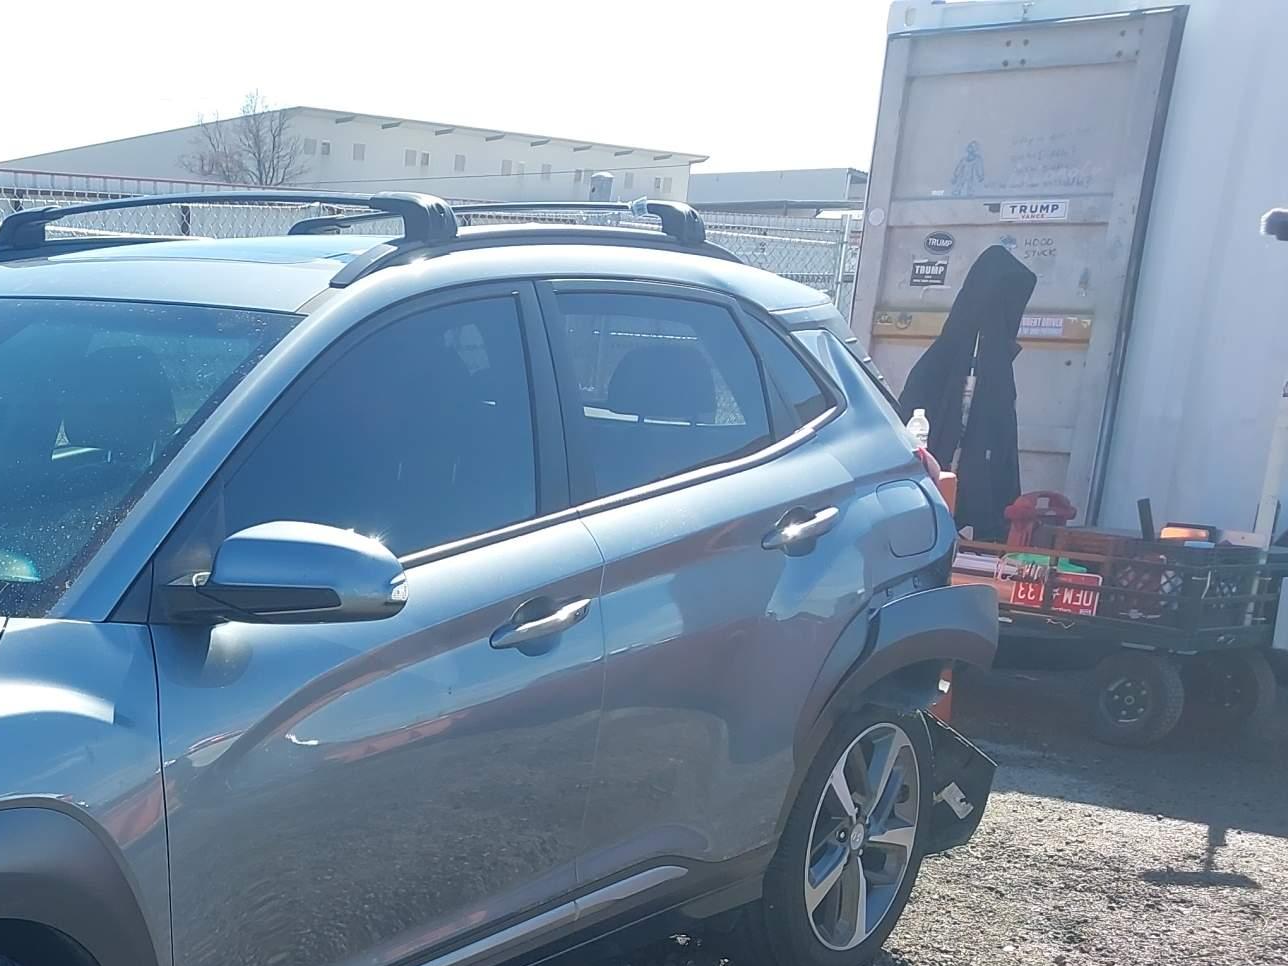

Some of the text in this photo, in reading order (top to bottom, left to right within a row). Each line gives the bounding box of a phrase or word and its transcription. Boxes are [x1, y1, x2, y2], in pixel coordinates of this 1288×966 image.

[1009, 204, 1059, 214] TRUMP
[928, 238, 953, 247] TRUMP
[1024, 238, 1054, 247] HOOD
[915, 265, 945, 275] TRUMP
